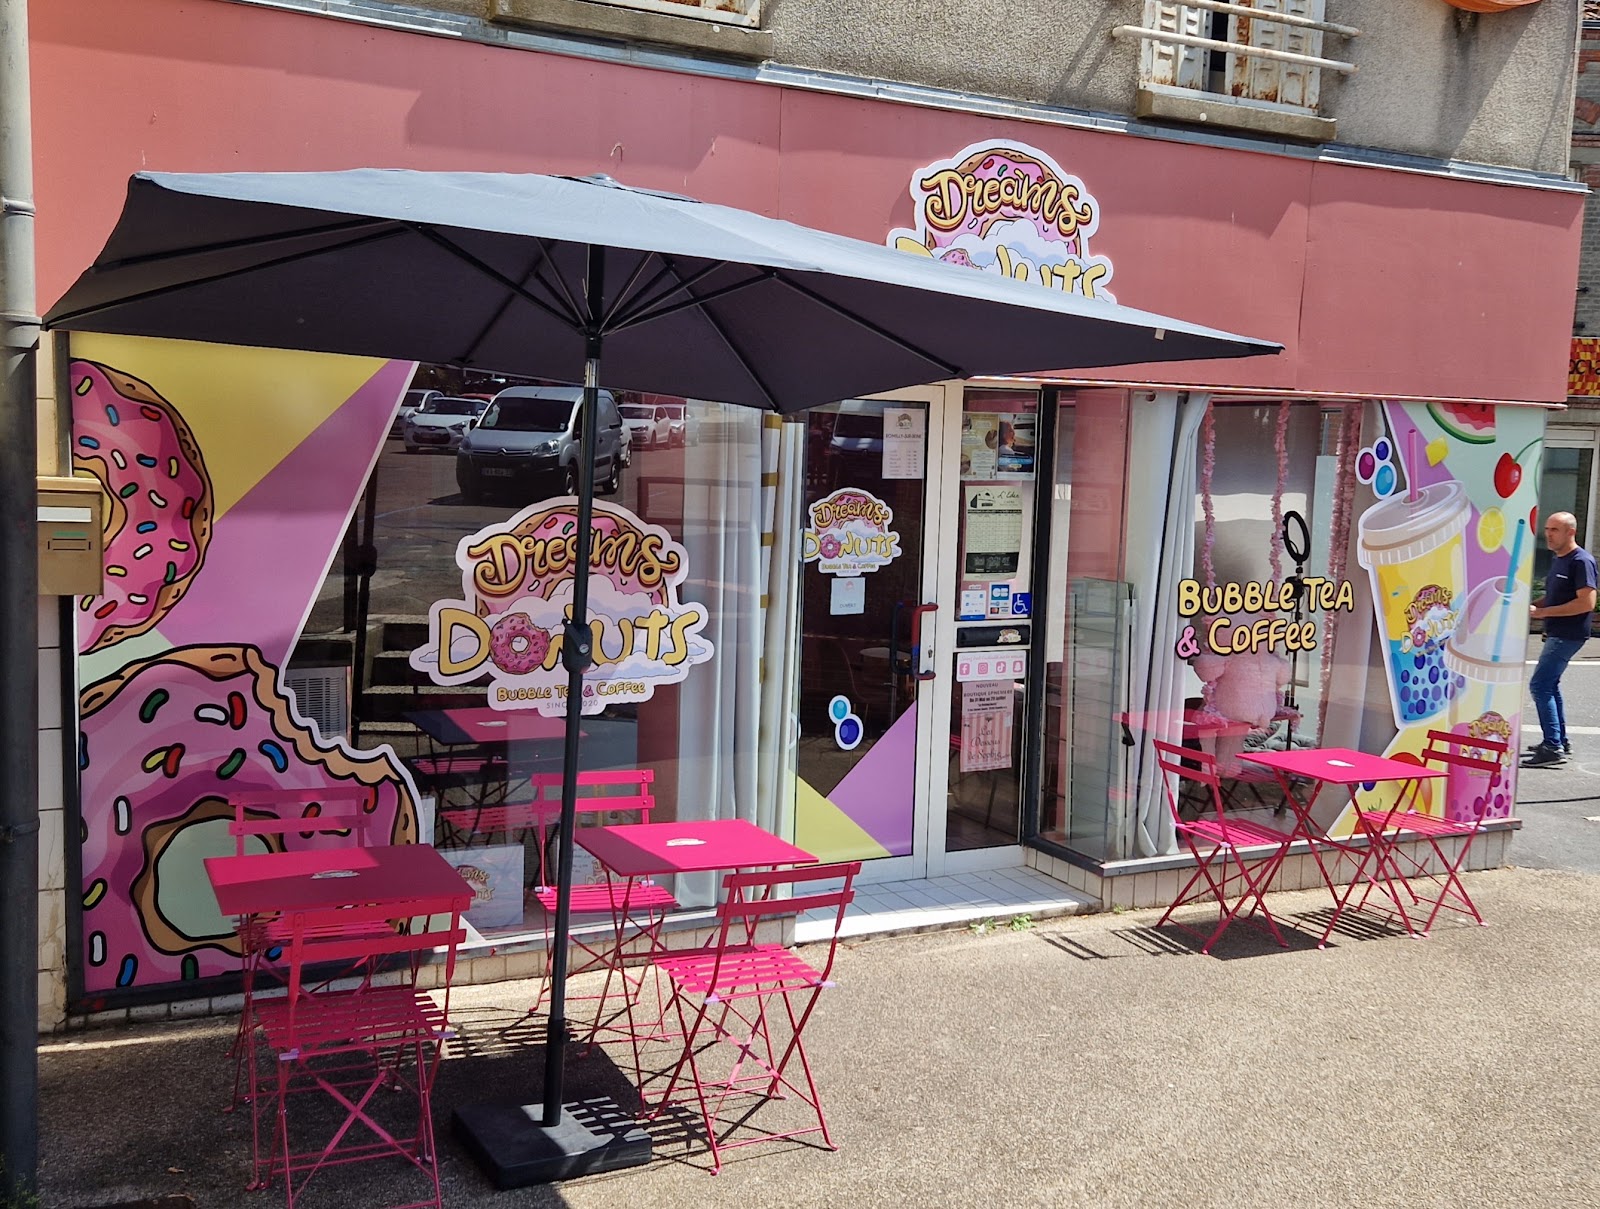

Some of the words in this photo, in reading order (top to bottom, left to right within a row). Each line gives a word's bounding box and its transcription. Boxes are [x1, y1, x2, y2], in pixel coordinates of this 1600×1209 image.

[920, 168, 1093, 237] Dreams
[813, 501, 889, 529] Dreams
[467, 530, 681, 596] Dreams
[1176, 626, 1201, 660] &
[582, 685, 594, 698] &
